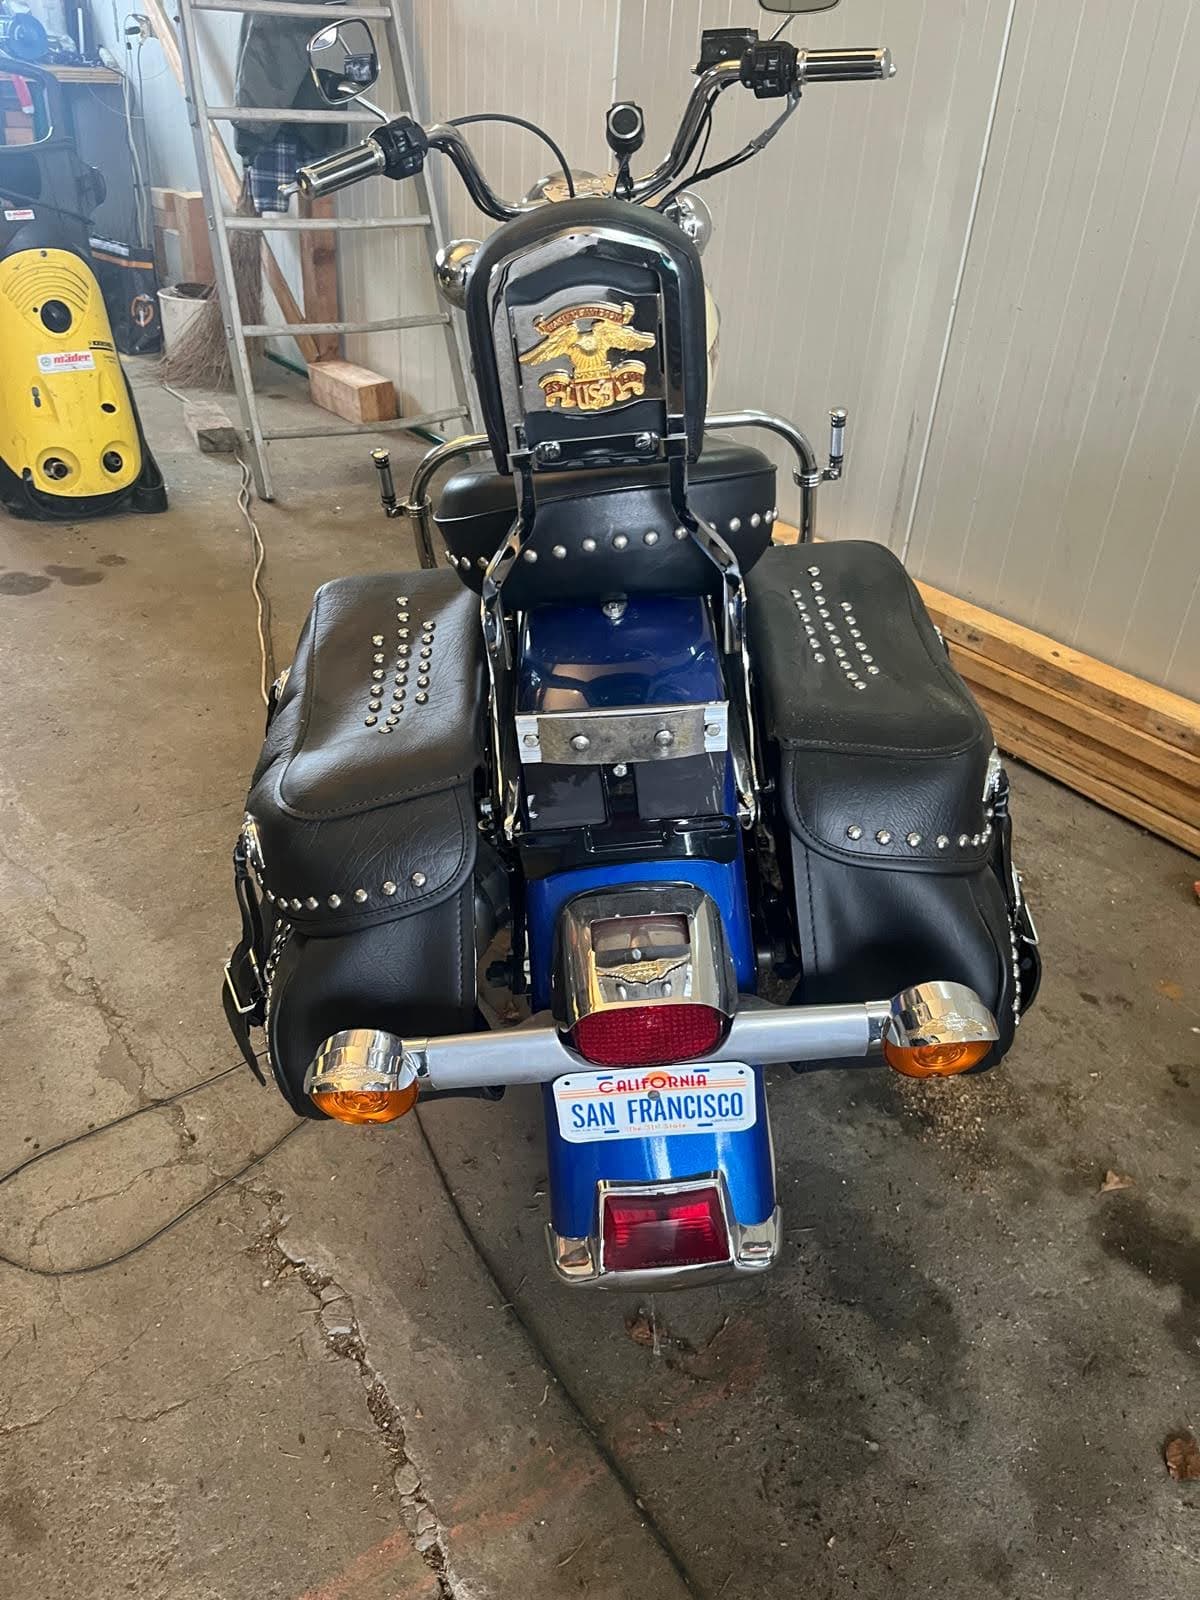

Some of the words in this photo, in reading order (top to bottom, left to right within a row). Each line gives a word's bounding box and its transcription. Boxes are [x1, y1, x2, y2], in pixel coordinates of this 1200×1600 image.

[598, 1074, 708, 1094] CALIFORNIA
[571, 1102, 615, 1128] SAN
[627, 1092, 744, 1124] FRANCISCO
